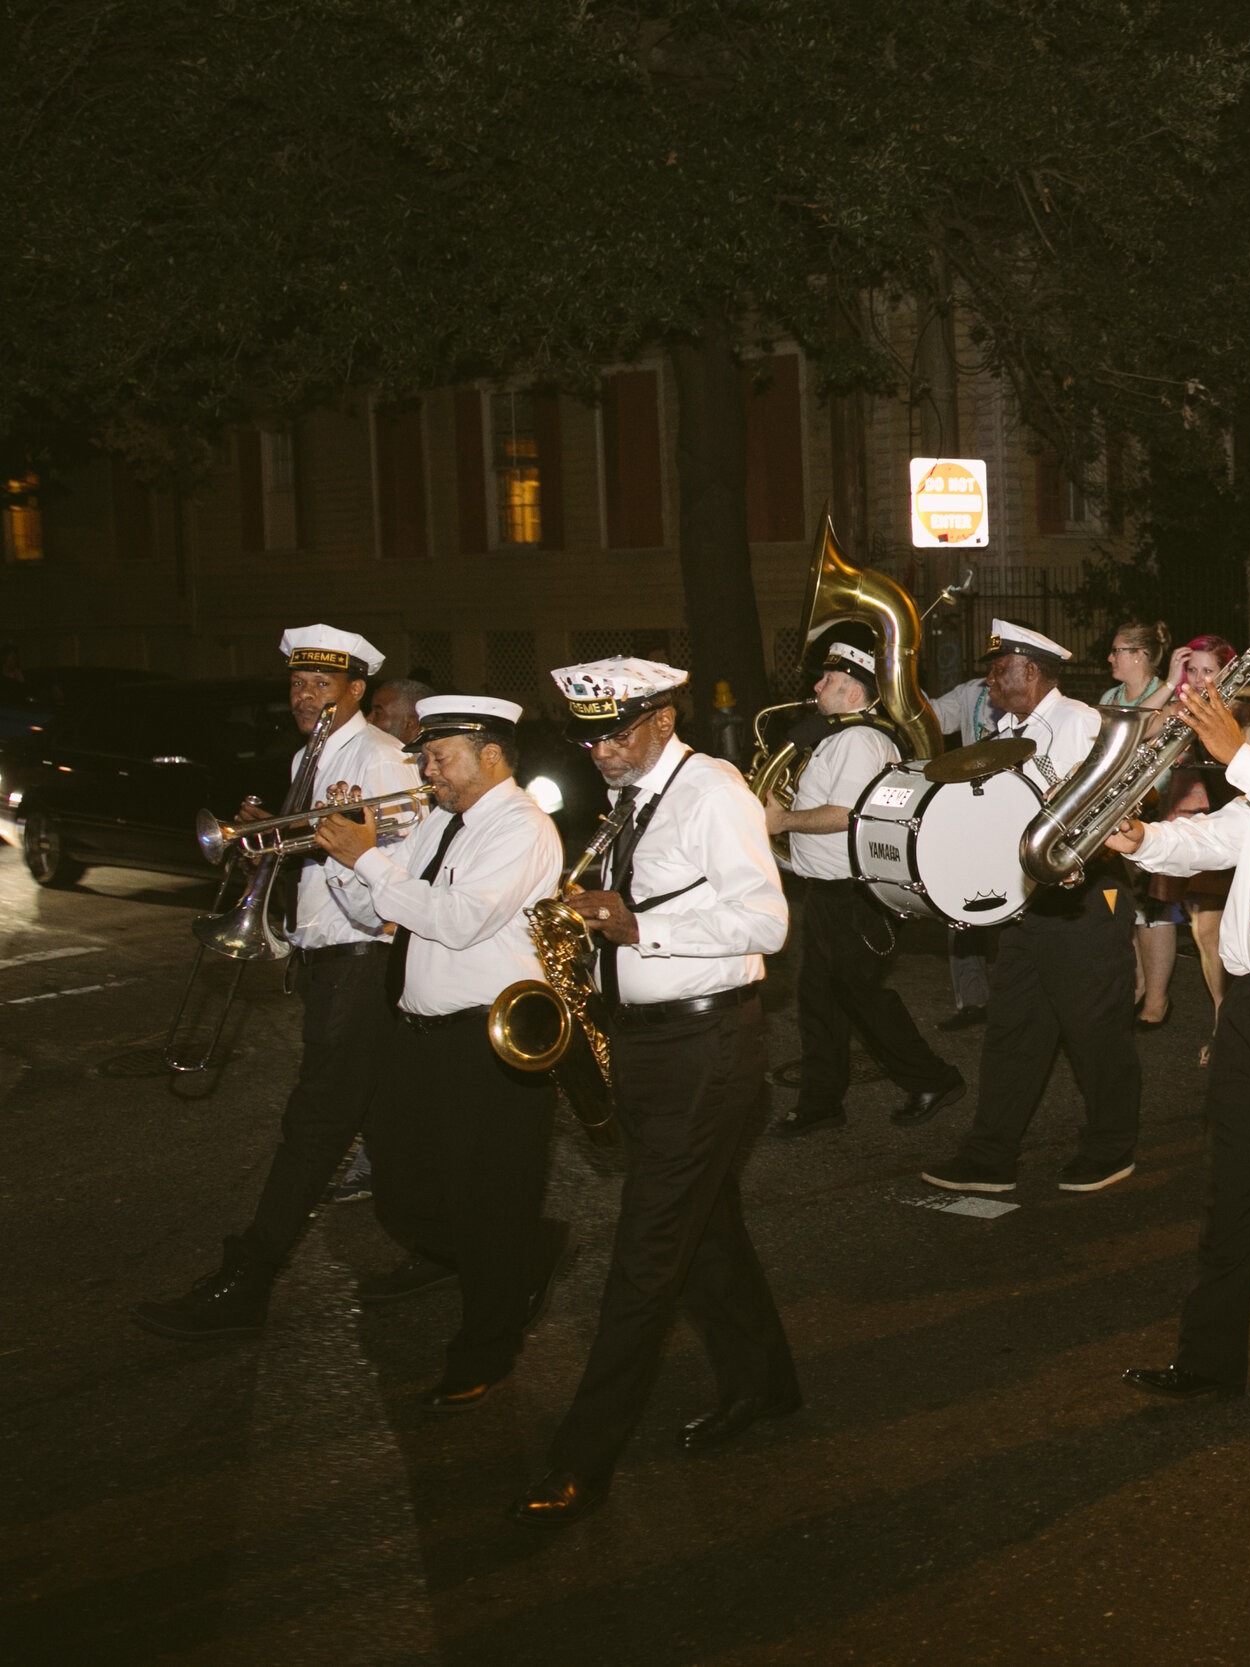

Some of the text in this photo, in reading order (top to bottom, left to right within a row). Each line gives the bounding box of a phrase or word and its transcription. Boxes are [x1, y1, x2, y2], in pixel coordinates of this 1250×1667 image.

[925, 477, 975, 492] DO NOT
[930, 514, 972, 529] ENTER
[300, 652, 337, 662] TREME
[868, 841, 901, 862] YAMAHA
